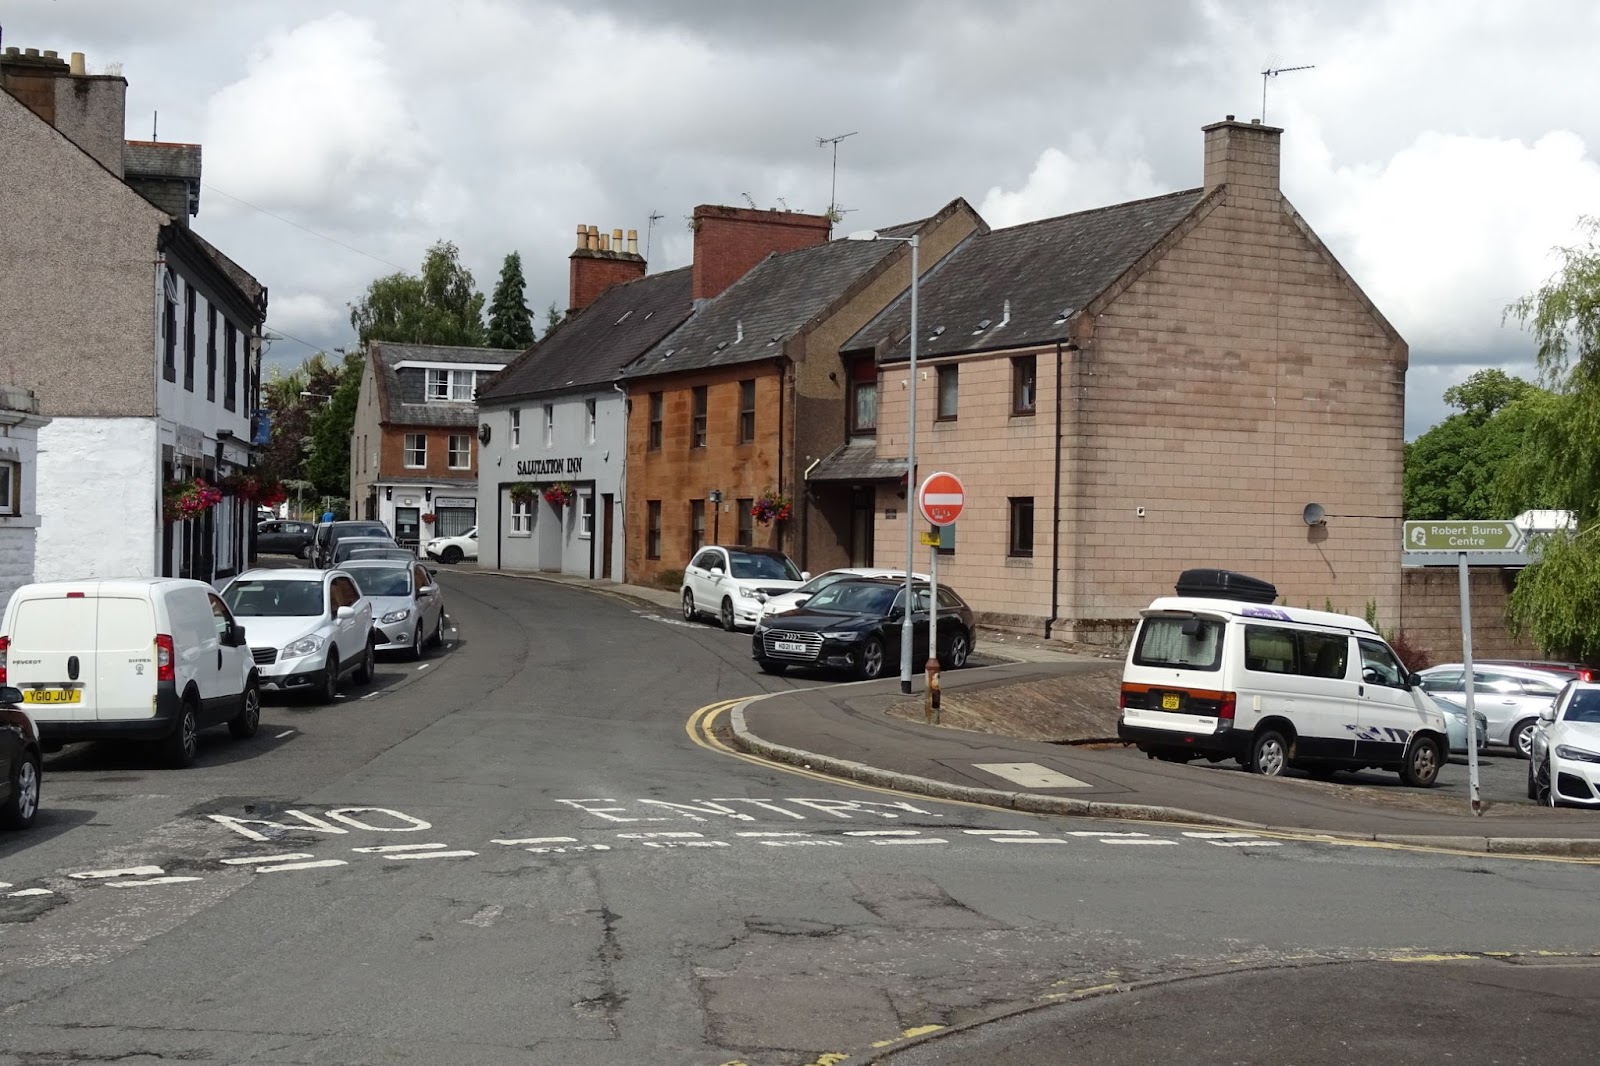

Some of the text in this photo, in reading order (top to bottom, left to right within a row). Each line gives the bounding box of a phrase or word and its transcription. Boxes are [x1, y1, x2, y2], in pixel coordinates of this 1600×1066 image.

[516, 457, 582, 475] SALUTATION INN
[1431, 526, 1503, 535] Robert Burns
[1448, 536, 1485, 546] Centre
[30, 691, 75, 702] YG10 JUV
[206, 797, 944, 841] NO ENTRY
